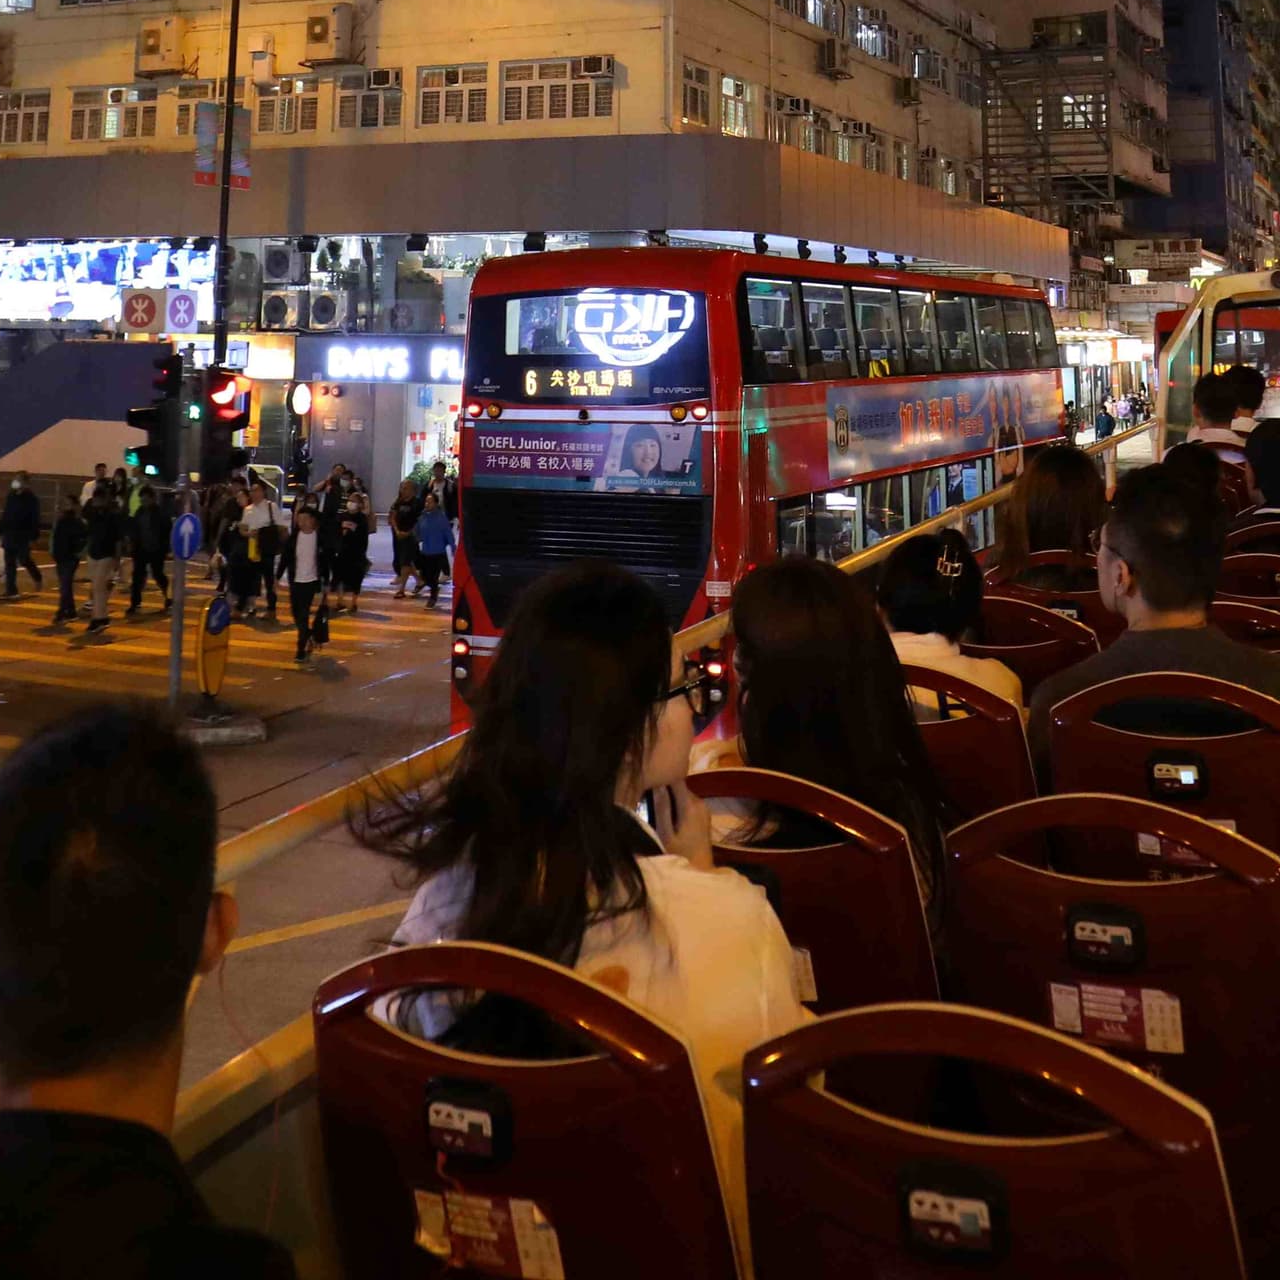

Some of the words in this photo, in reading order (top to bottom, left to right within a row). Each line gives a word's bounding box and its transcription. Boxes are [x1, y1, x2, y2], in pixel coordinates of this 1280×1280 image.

[328, 347, 409, 378] DAYS
[525, 370, 537, 396] 6
[479, 435, 516, 449] TOEFL
[486, 454, 531, 470] 升中必備
